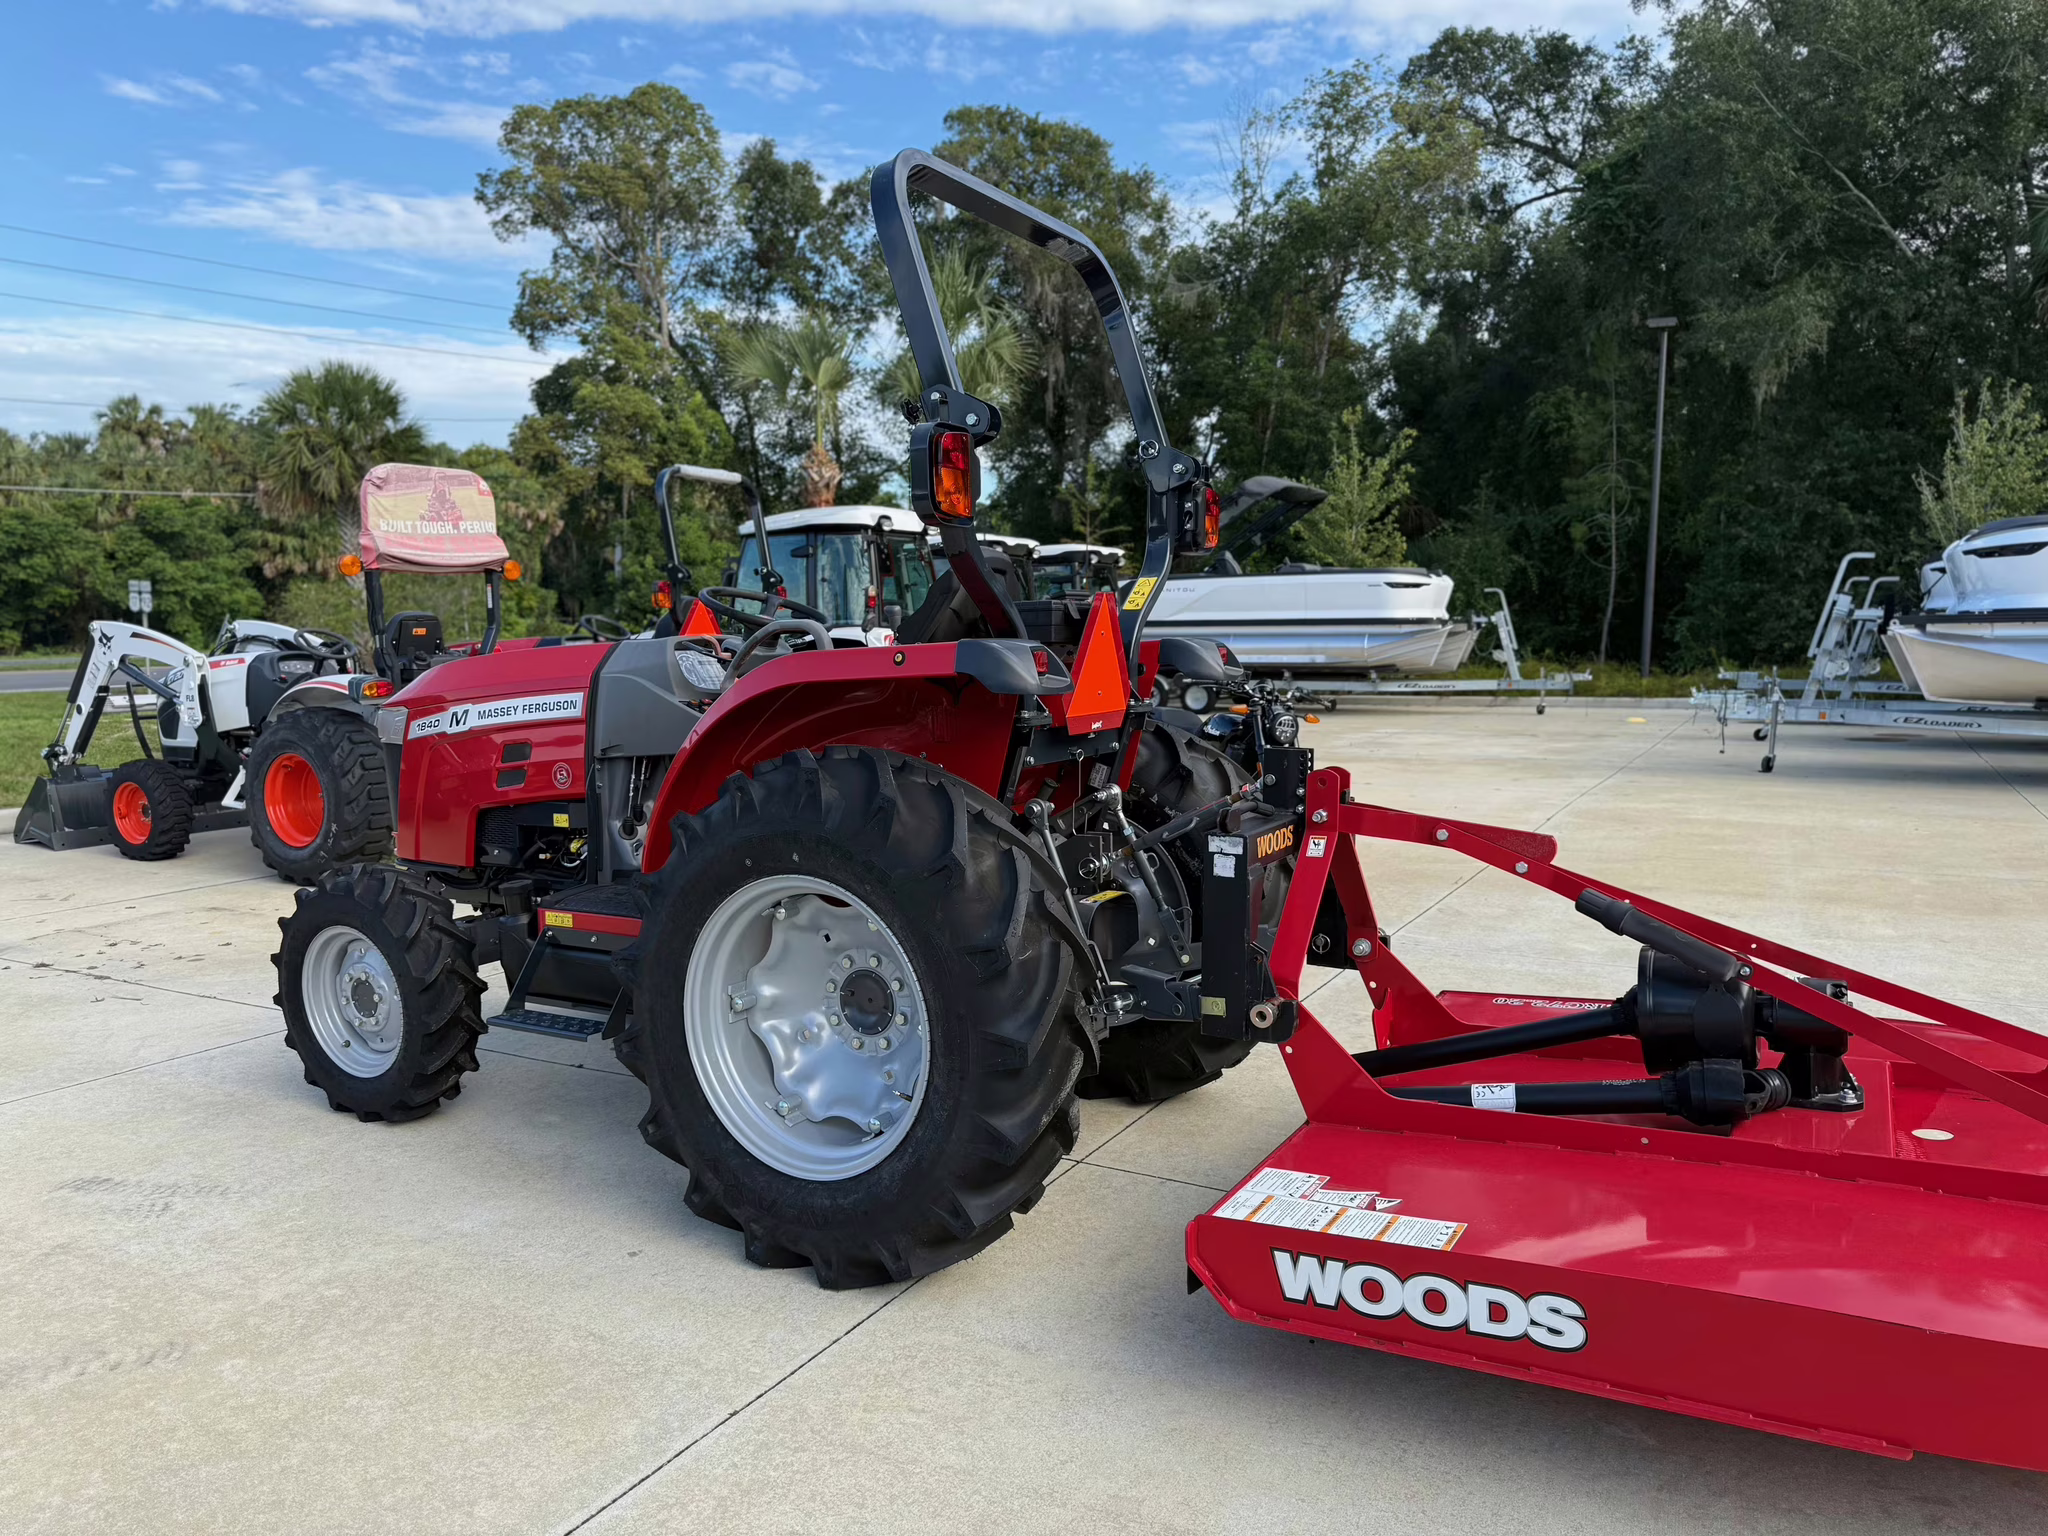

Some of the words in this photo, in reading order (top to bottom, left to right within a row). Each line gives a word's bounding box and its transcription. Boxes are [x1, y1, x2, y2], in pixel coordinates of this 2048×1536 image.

[380, 520, 413, 534] BUILT
[416, 521, 458, 535] TOUGH.
[416, 718, 441, 733] 1840
[477, 705, 520, 721] MASSEY
[522, 699, 578, 715] FERGUSON
[1256, 824, 1295, 859] WOODS
[1270, 1247, 1589, 1353] WOODS
